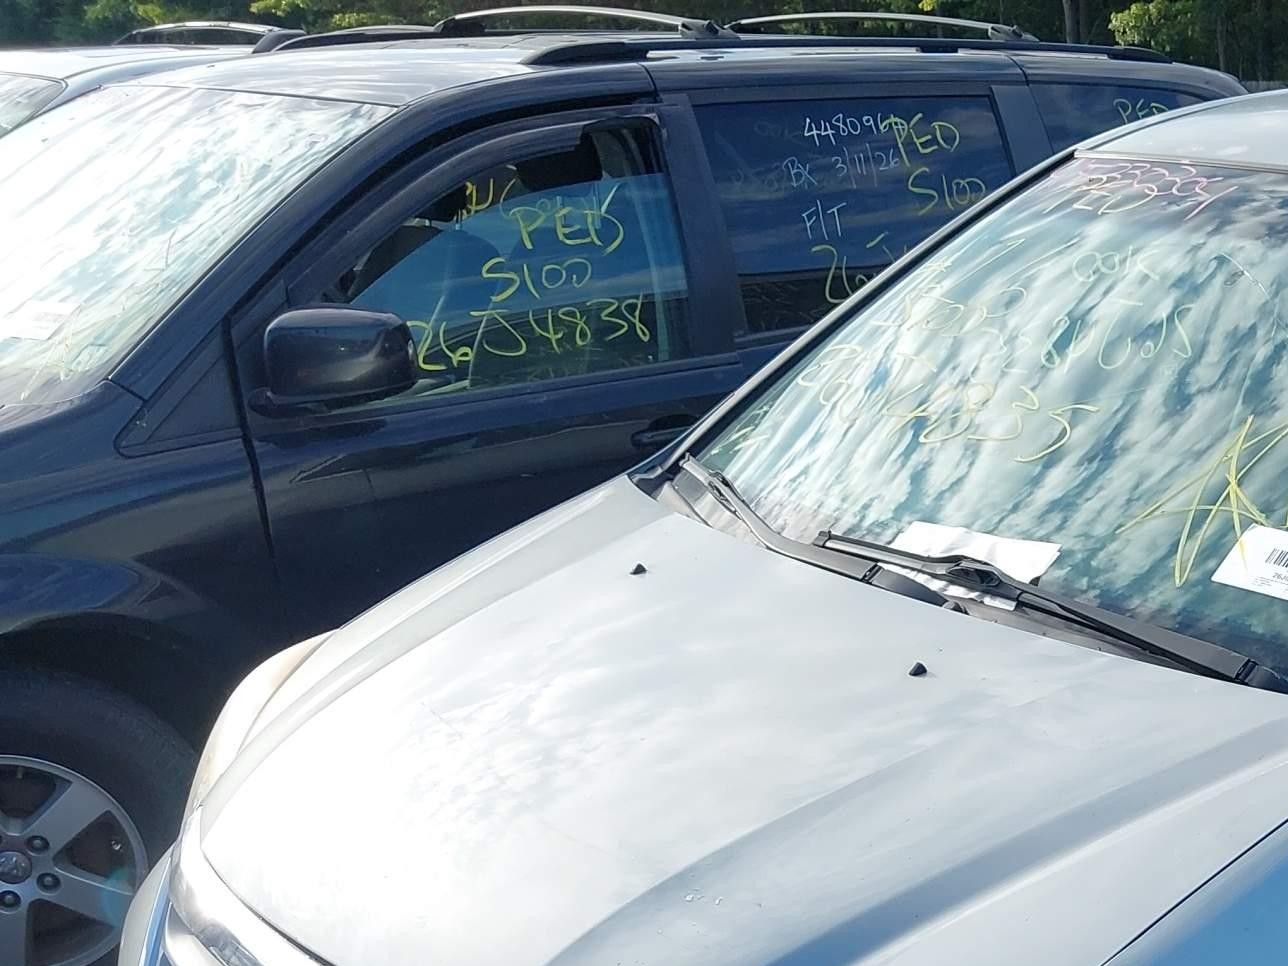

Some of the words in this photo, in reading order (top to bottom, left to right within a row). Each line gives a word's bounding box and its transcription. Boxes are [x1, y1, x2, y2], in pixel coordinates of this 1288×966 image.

[884, 112, 960, 168] PED
[907, 167, 986, 216] S100
[508, 204, 625, 257] PED
[801, 199, 848, 241] F/T
[481, 256, 593, 303] S100
[406, 291, 650, 371] 26J4838
